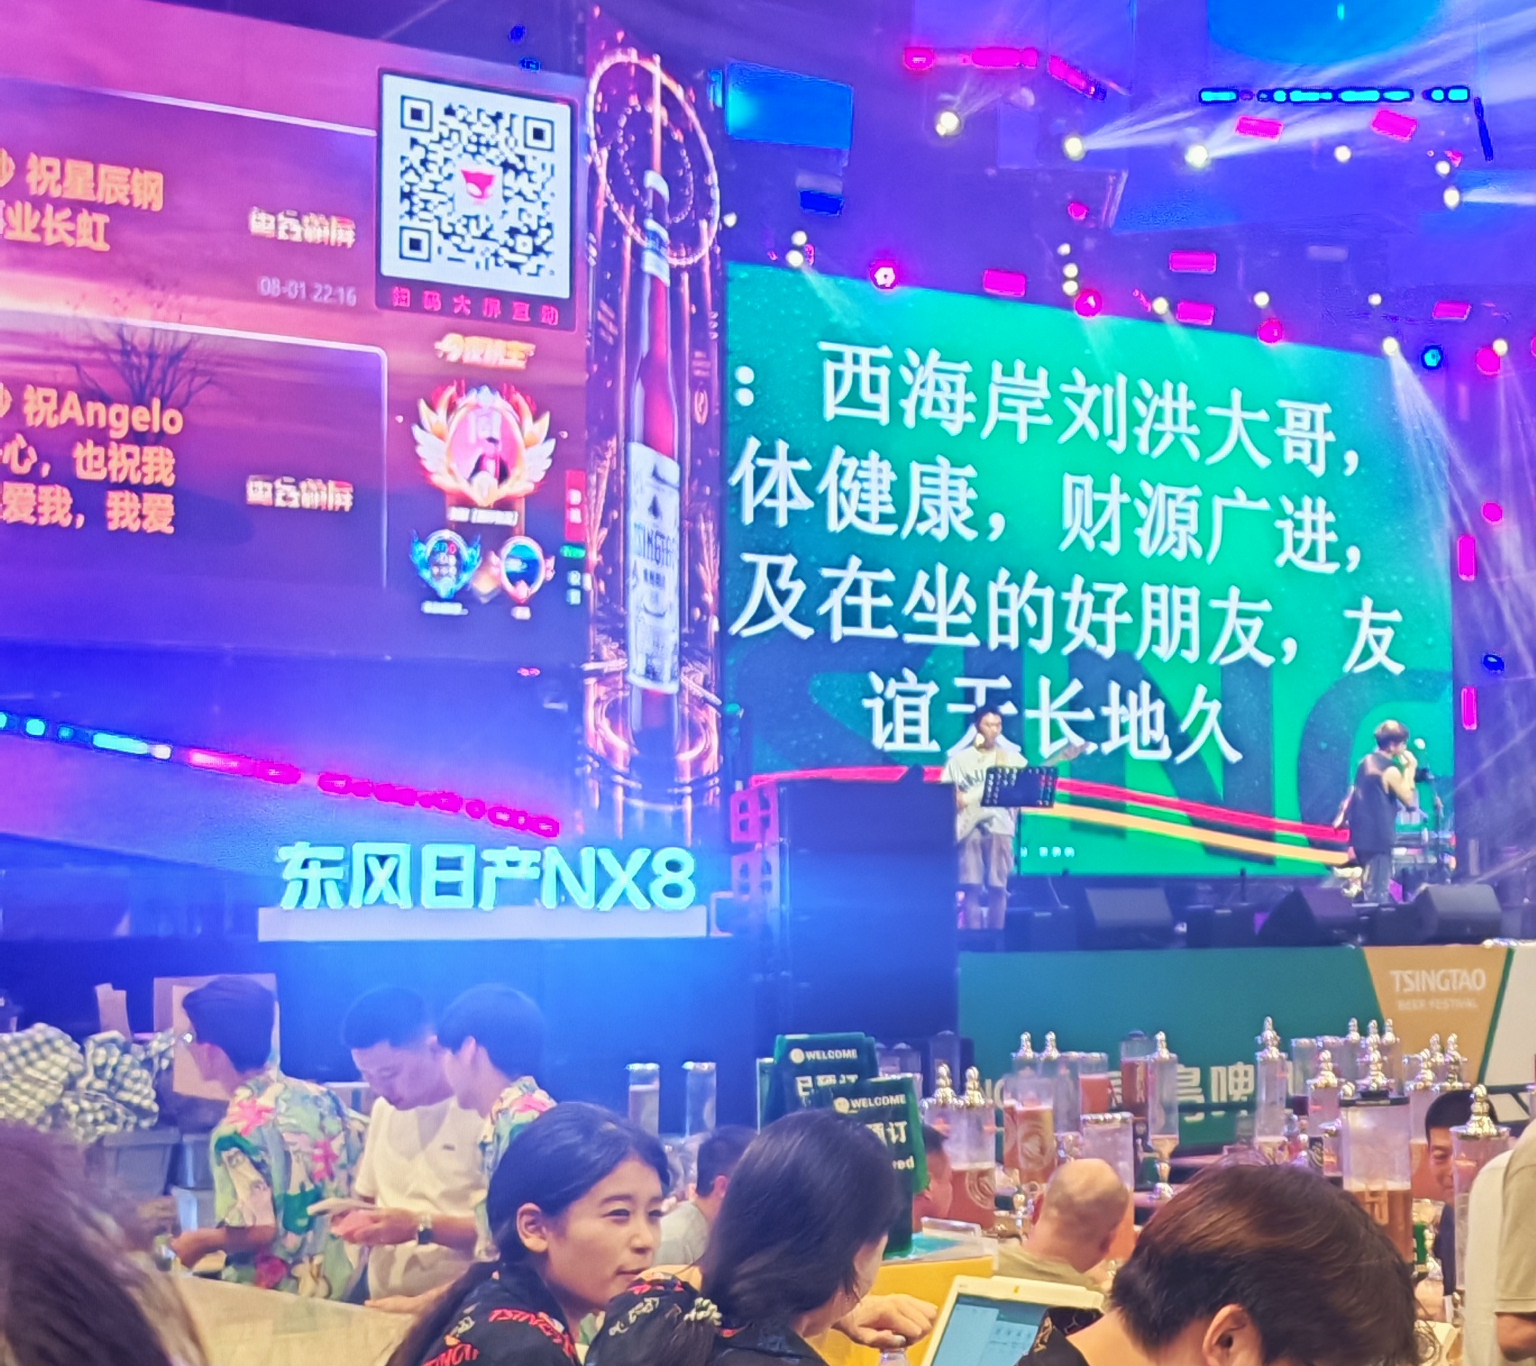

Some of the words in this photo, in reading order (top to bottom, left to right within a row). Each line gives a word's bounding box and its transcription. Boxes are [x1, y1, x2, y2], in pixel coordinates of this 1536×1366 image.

[0, 199, 111, 252] 业长虹
[22, 383, 185, 440] 祝Angelo
[0, 432, 177, 488] 心，也祝我
[0, 480, 176, 535] 爱我，我爱
[277, 841, 697, 912] 东风日产NX8
[1389, 968, 1487, 994] TSINGTAO
[805, 1047, 858, 1063] WELCOME
[850, 1094, 907, 1111] WELCOME
